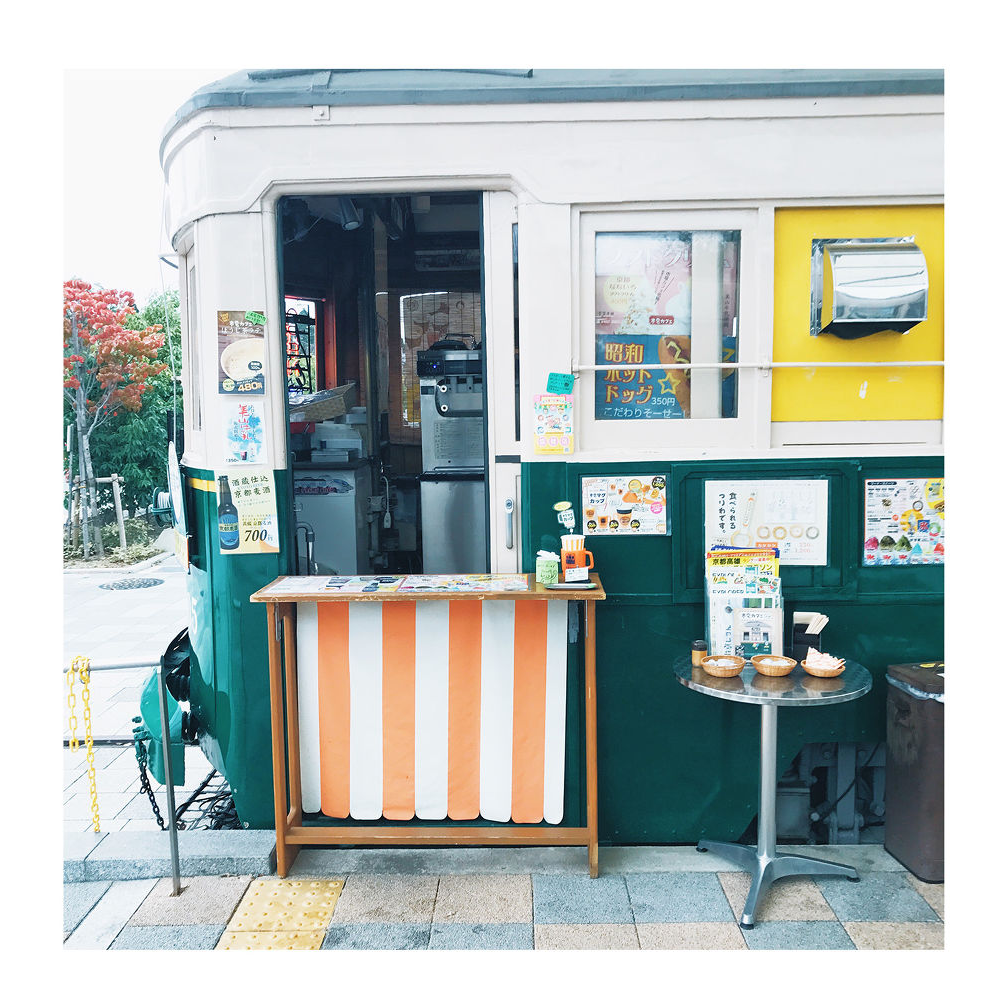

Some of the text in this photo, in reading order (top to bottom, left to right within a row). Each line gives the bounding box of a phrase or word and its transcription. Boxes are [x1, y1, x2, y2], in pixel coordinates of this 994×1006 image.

[605, 342, 644, 364] 昭和
[606, 384, 653, 404] ドッグ
[651, 397, 676, 406] 350円
[729, 492, 737, 530] 食べられる
